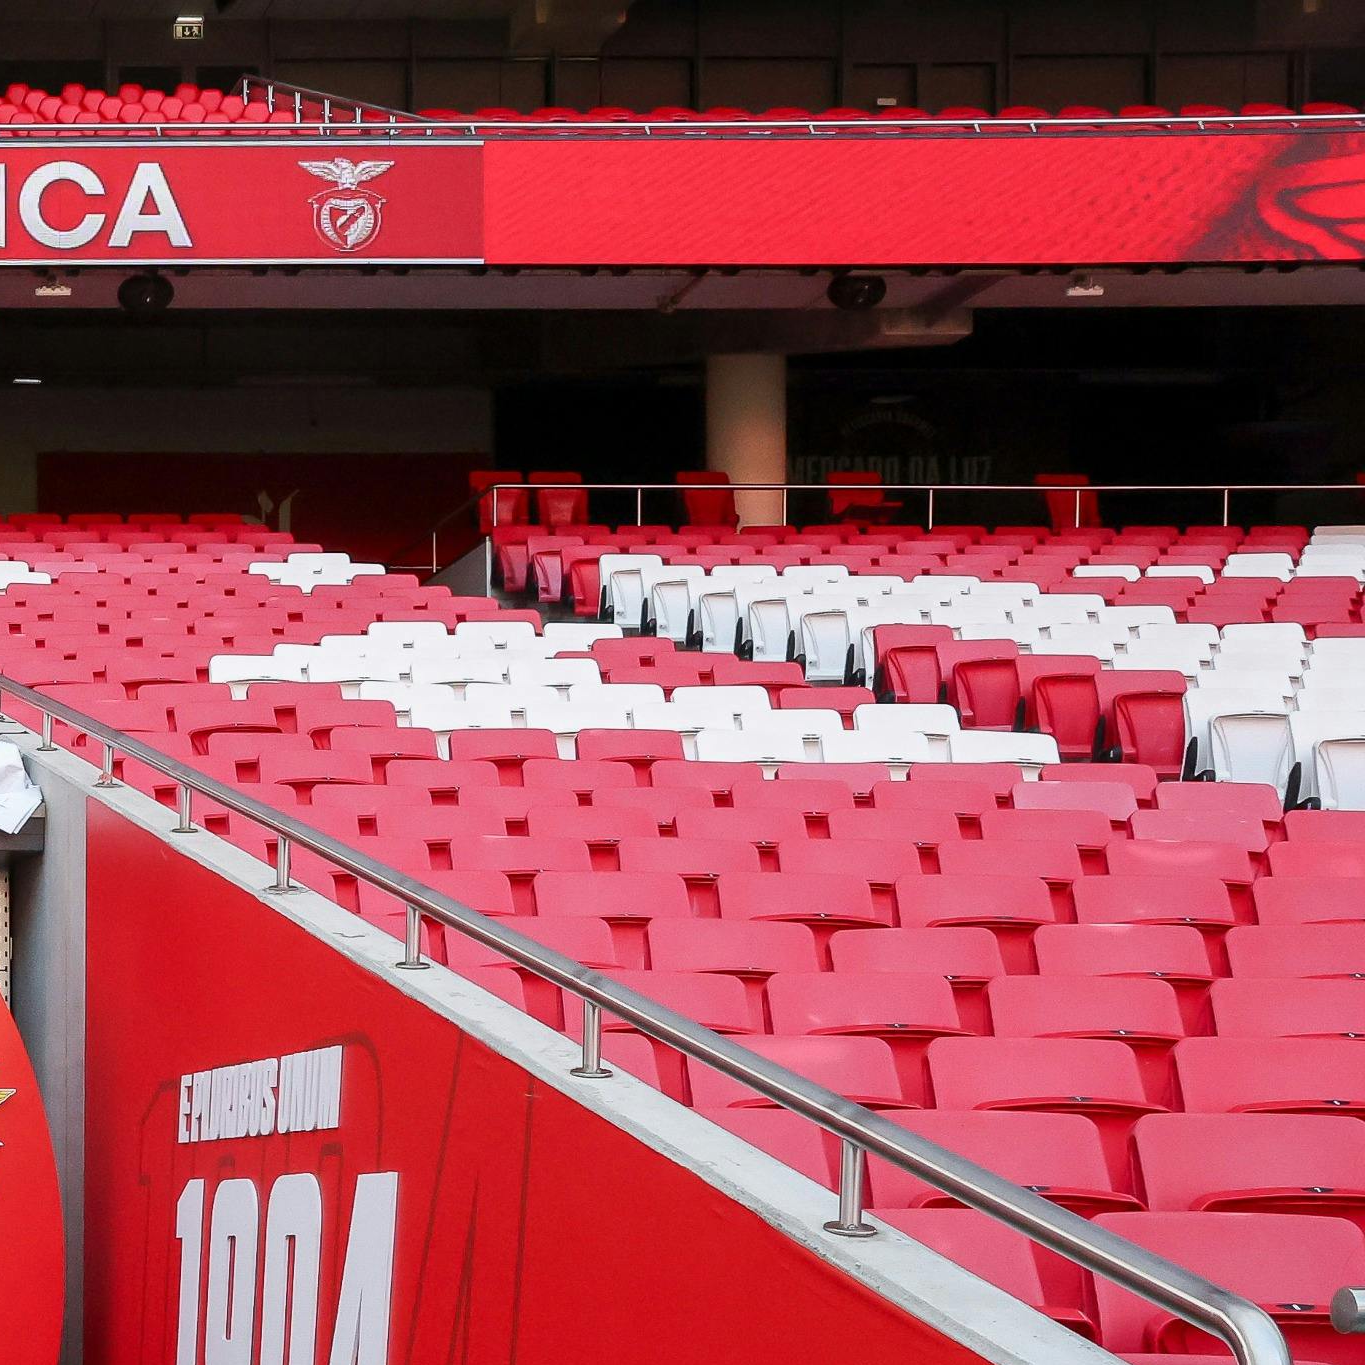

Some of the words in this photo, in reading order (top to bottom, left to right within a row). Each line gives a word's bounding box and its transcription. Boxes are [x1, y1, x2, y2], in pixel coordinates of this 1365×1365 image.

[177, 1074, 193, 1144] E
[190, 1058, 279, 1143] PLURIBUS
[277, 1045, 343, 1134] UNUM
